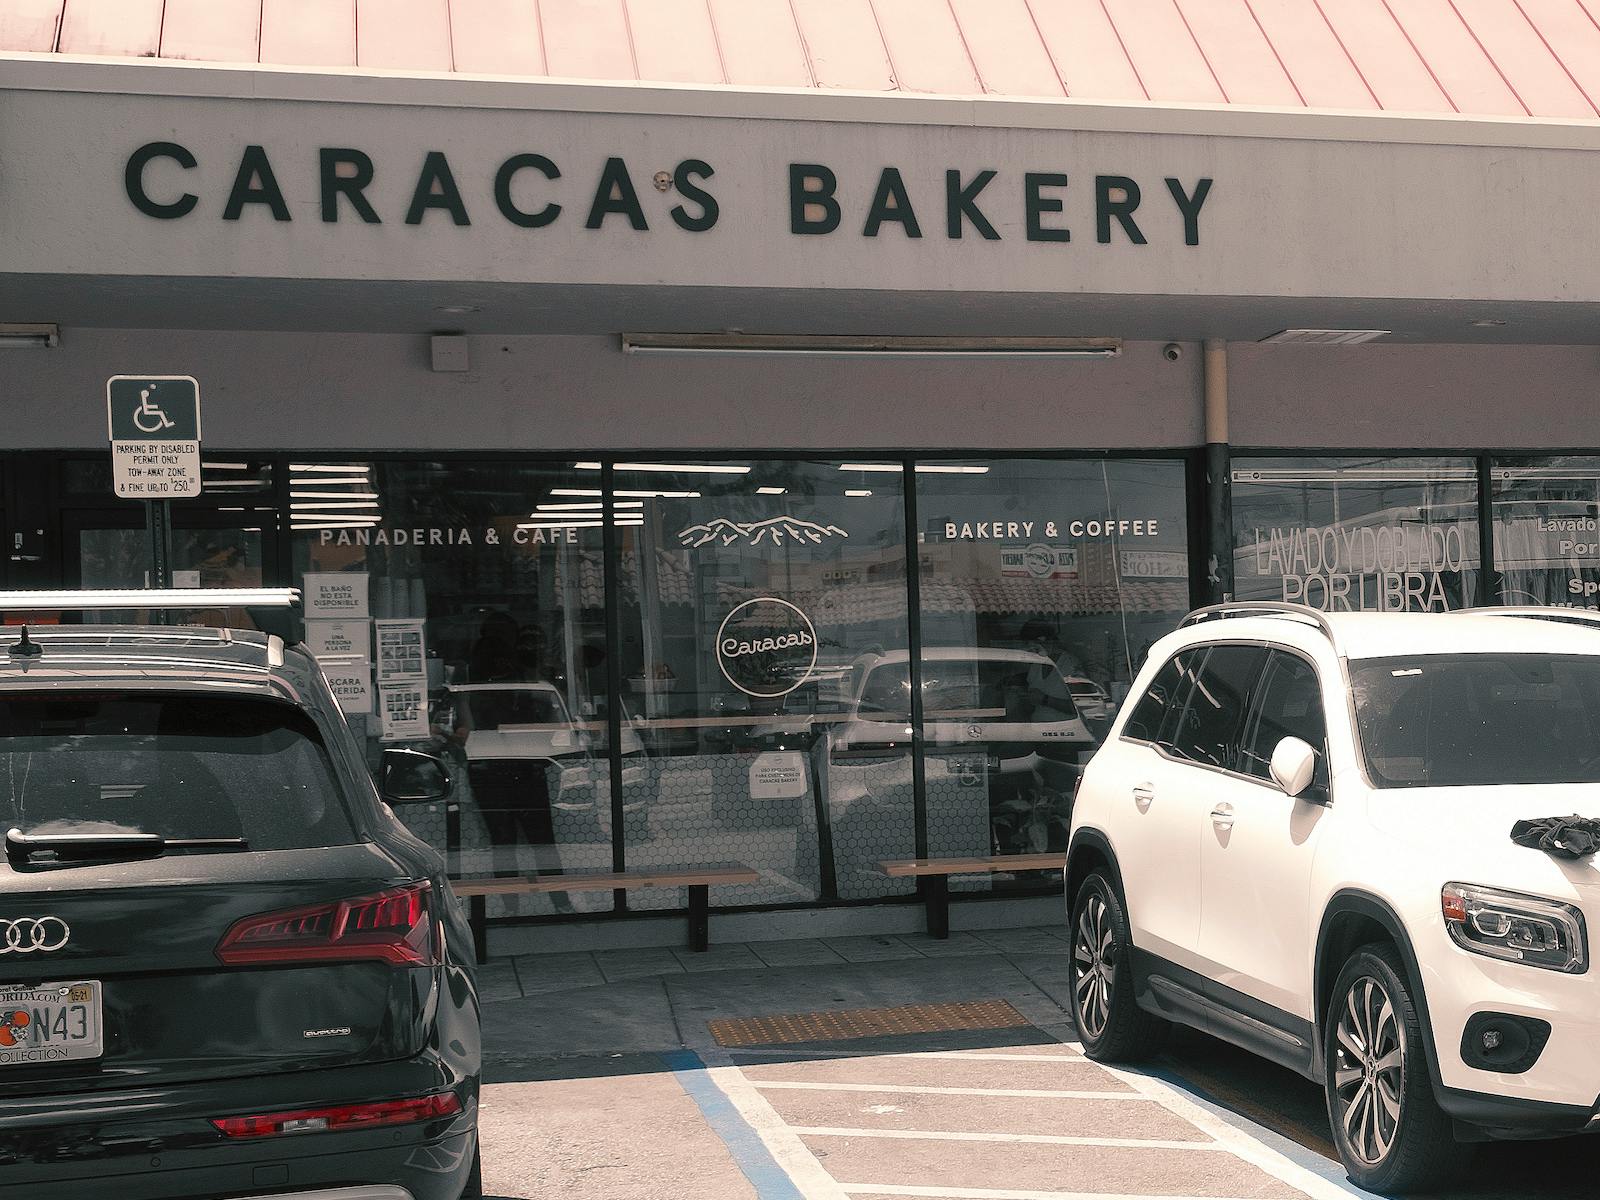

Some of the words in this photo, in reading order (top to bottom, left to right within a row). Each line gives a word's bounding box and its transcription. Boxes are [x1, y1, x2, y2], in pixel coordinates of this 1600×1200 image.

[125, 142, 719, 232] CARACAS
[789, 163, 1213, 246] BAKERY
[116, 445, 146, 454] PARKING
[149, 445, 158, 454] BY
[161, 445, 195, 454] DISABLED
[133, 456, 158, 464] PERMIT
[161, 456, 179, 464] ONLY
[128, 468, 164, 477] TOW-AWAY
[167, 467, 187, 477] ZONE
[120, 483, 126, 492] &
[128, 483, 144, 492] FINE
[147, 483, 158, 492] UP
[160, 483, 169, 491] TO
[945, 521, 1034, 539] BAKERY
[1045, 521, 1058, 538] &
[1069, 519, 1159, 537] COFFEE
[1537, 516, 1597, 532] Lavado
[320, 528, 472, 546] PANADERIA
[485, 527, 499, 545] &
[513, 528, 578, 545] CAFE
[1255, 526, 1339, 575] LAVADO
[1341, 526, 1356, 573] Y
[1360, 525, 1463, 573] DOBLADO
[1559, 540, 1598, 555] Por
[319, 585, 330, 593] EL
[1282, 573, 1352, 612] POR
[1359, 572, 1450, 612] LIBRA
[721, 630, 813, 658] Caracas
[328, 678, 361, 686] SCARA
[334, 687, 366, 695] ERIDA
[0, 991, 60, 1003] ORIDA.COM
[33, 1005, 87, 1042] N43
[305, 1028, 349, 1036] quattro
[0, 1048, 68, 1063] OLLECTION
